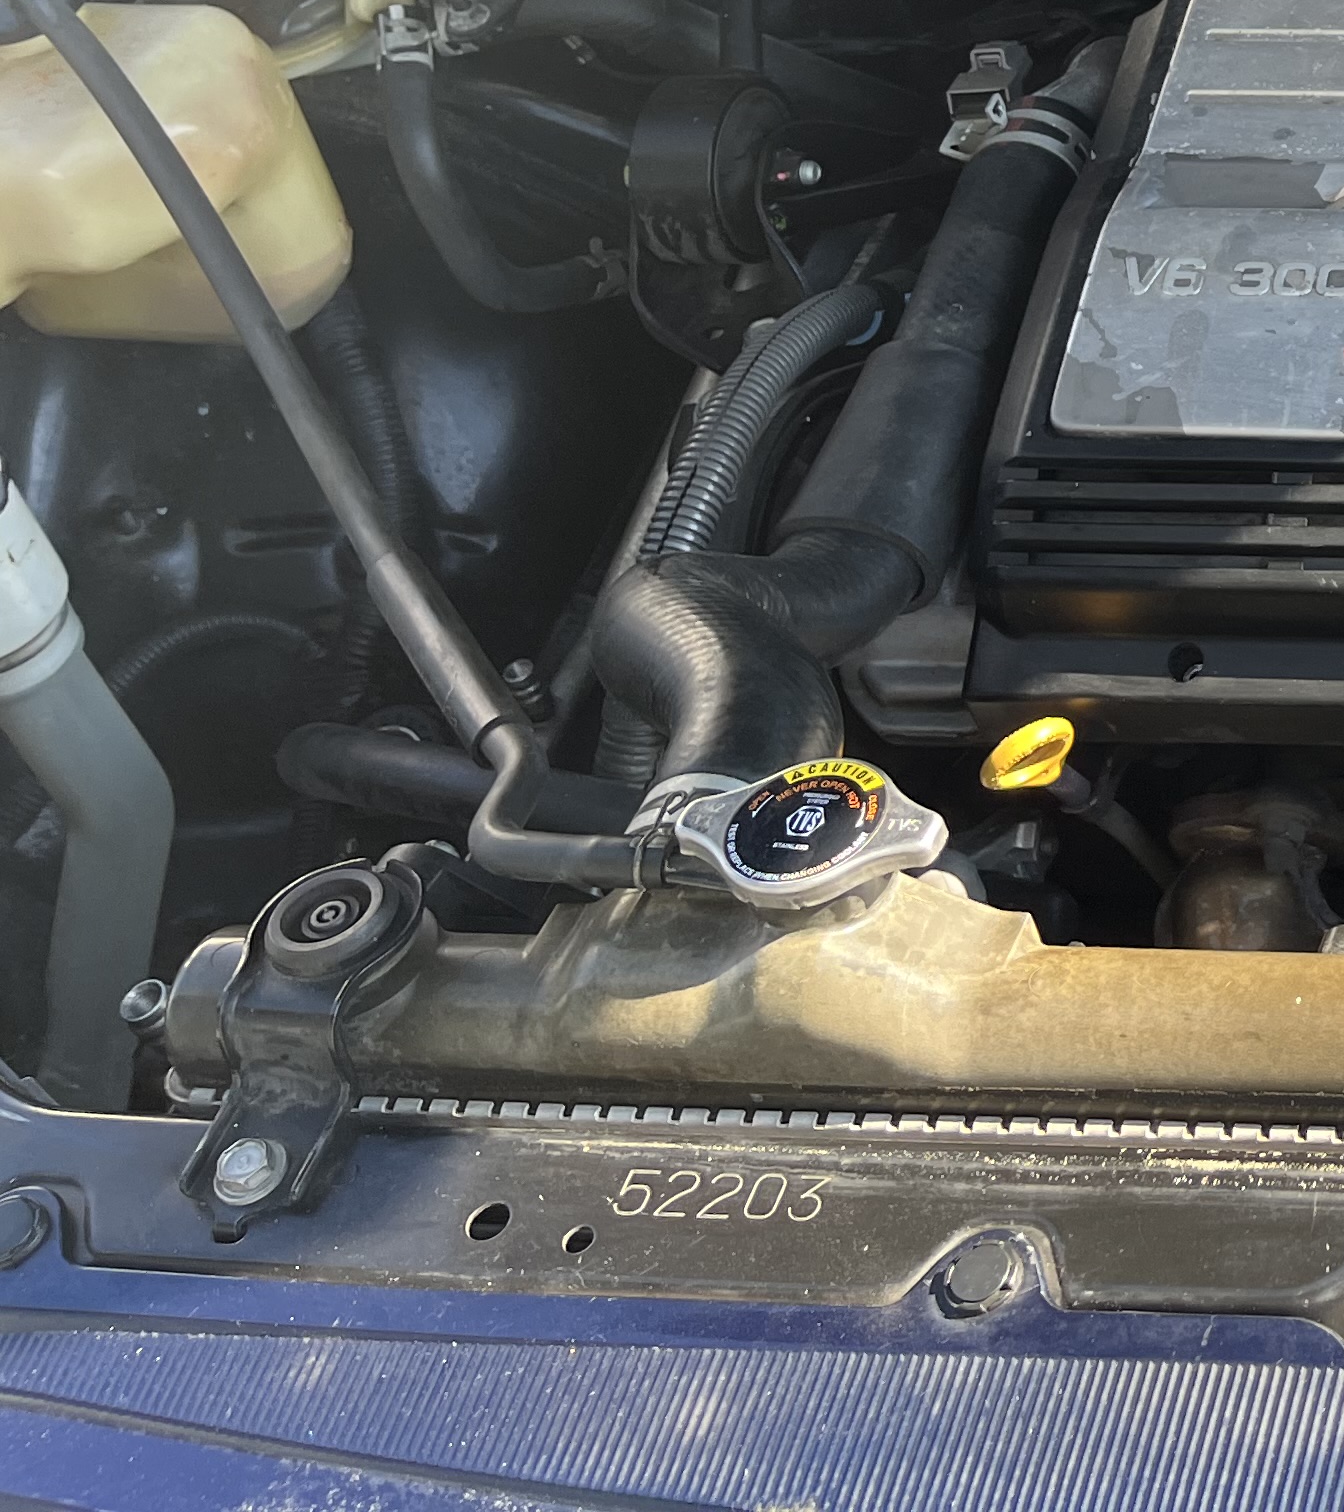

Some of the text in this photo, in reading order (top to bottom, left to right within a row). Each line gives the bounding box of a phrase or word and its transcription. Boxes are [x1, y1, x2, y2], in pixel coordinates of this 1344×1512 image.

[1125, 255, 1208, 297] V6
[808, 762, 877, 785] CAUTION
[747, 790, 771, 811] OPEN
[775, 779, 819, 803] NEVER
[820, 779, 850, 794] OPEN
[865, 793, 878, 821] CLOSE
[727, 823, 740, 841] TEST
[795, 809, 822, 832] TVS
[887, 817, 921, 832] TVS
[830, 831, 870, 865] COOLANT
[729, 851, 756, 876] REPLACE
[780, 860, 832, 881] CHANGING
[751, 871, 780, 881] WHEN
[611, 1168, 832, 1222] 52203
